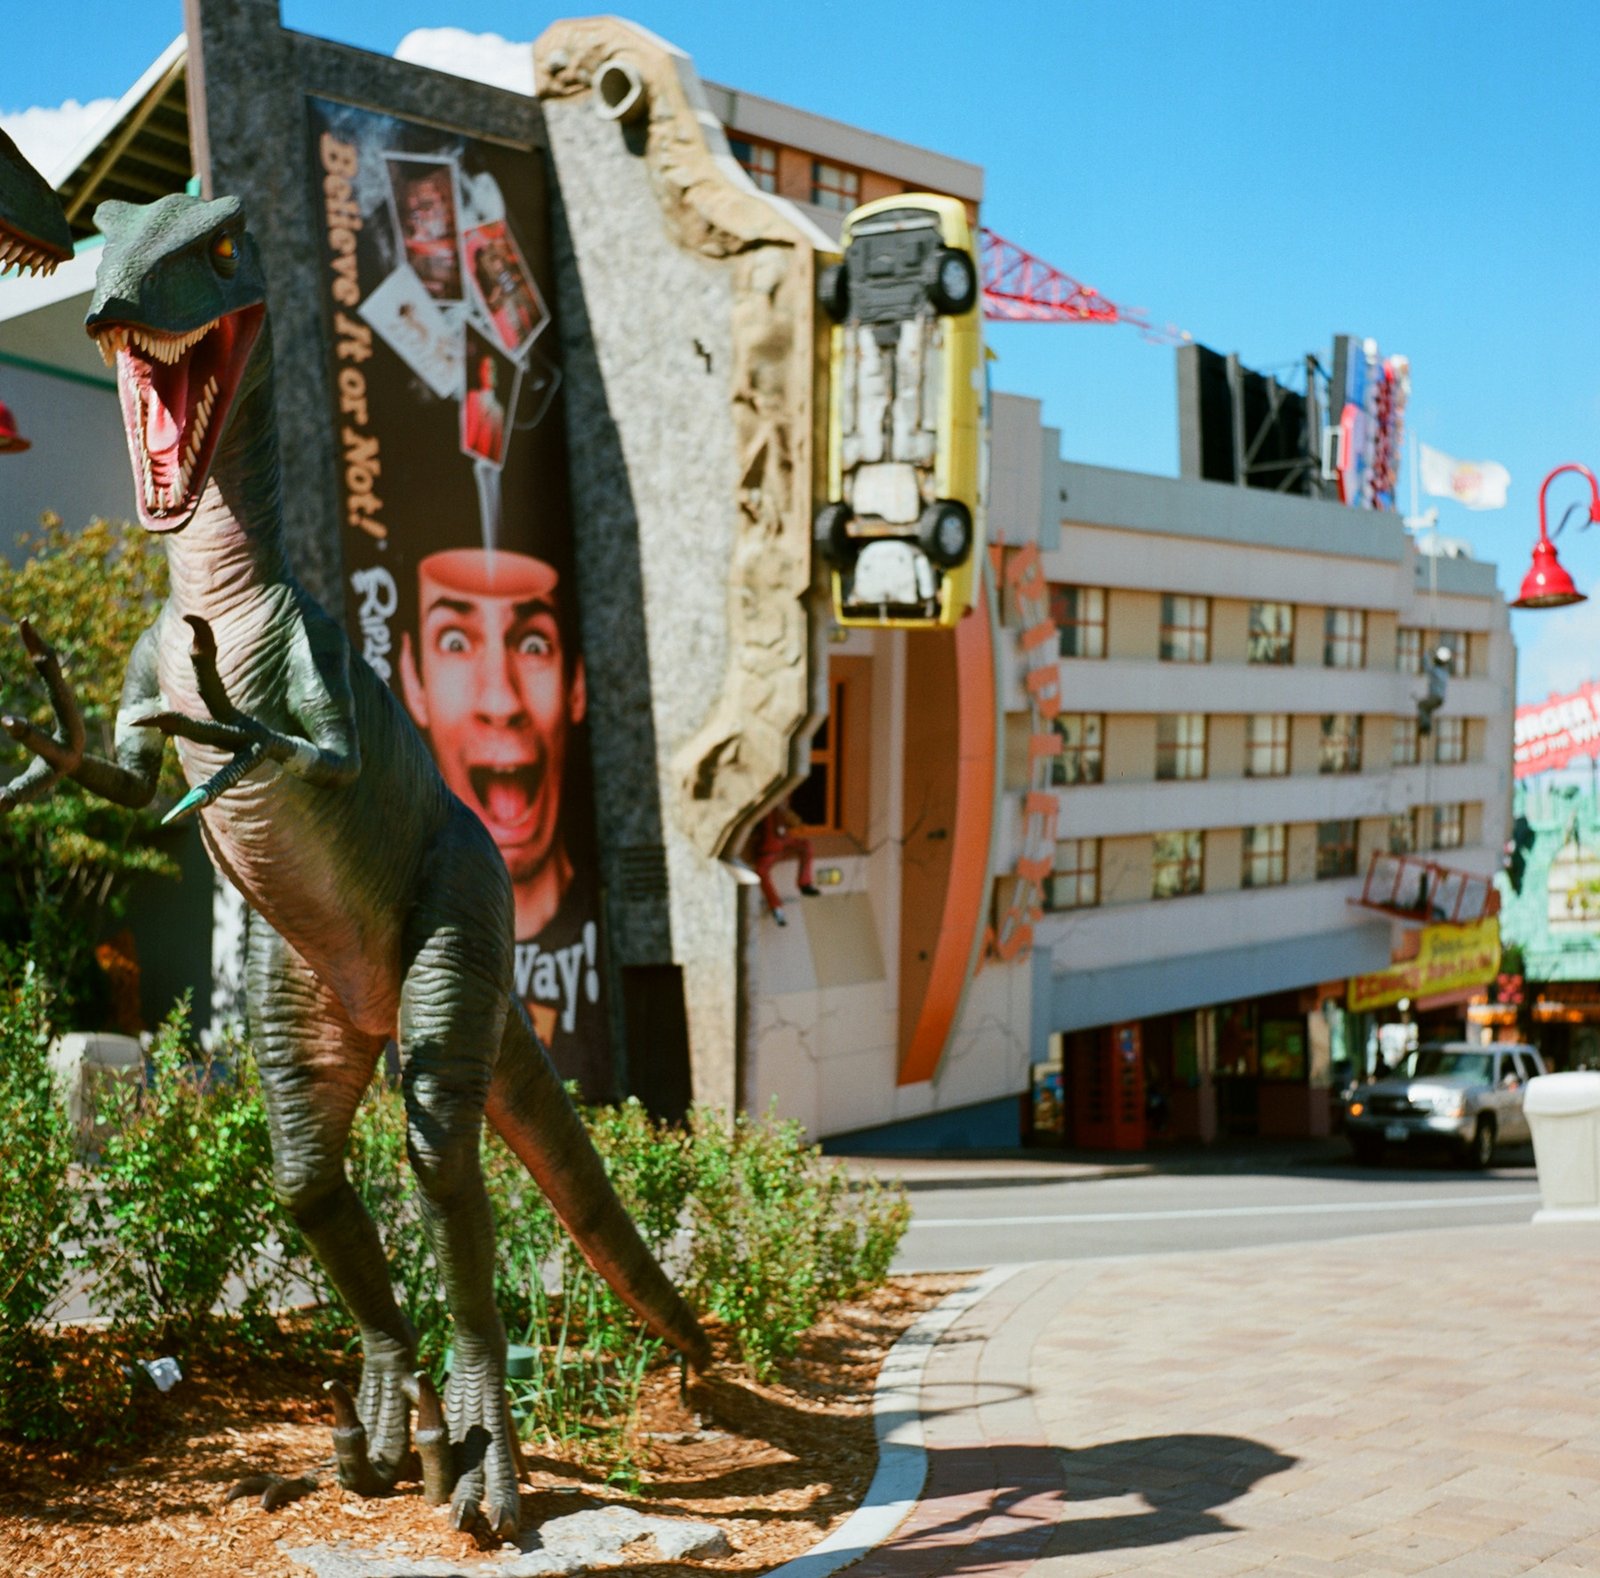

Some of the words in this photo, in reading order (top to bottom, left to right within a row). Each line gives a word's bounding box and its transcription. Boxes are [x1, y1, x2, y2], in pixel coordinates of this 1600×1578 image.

[320, 132, 363, 306] Believe
[335, 311, 373, 362] It
[338, 367, 368, 425] or
[342, 426, 387, 538] Not!
